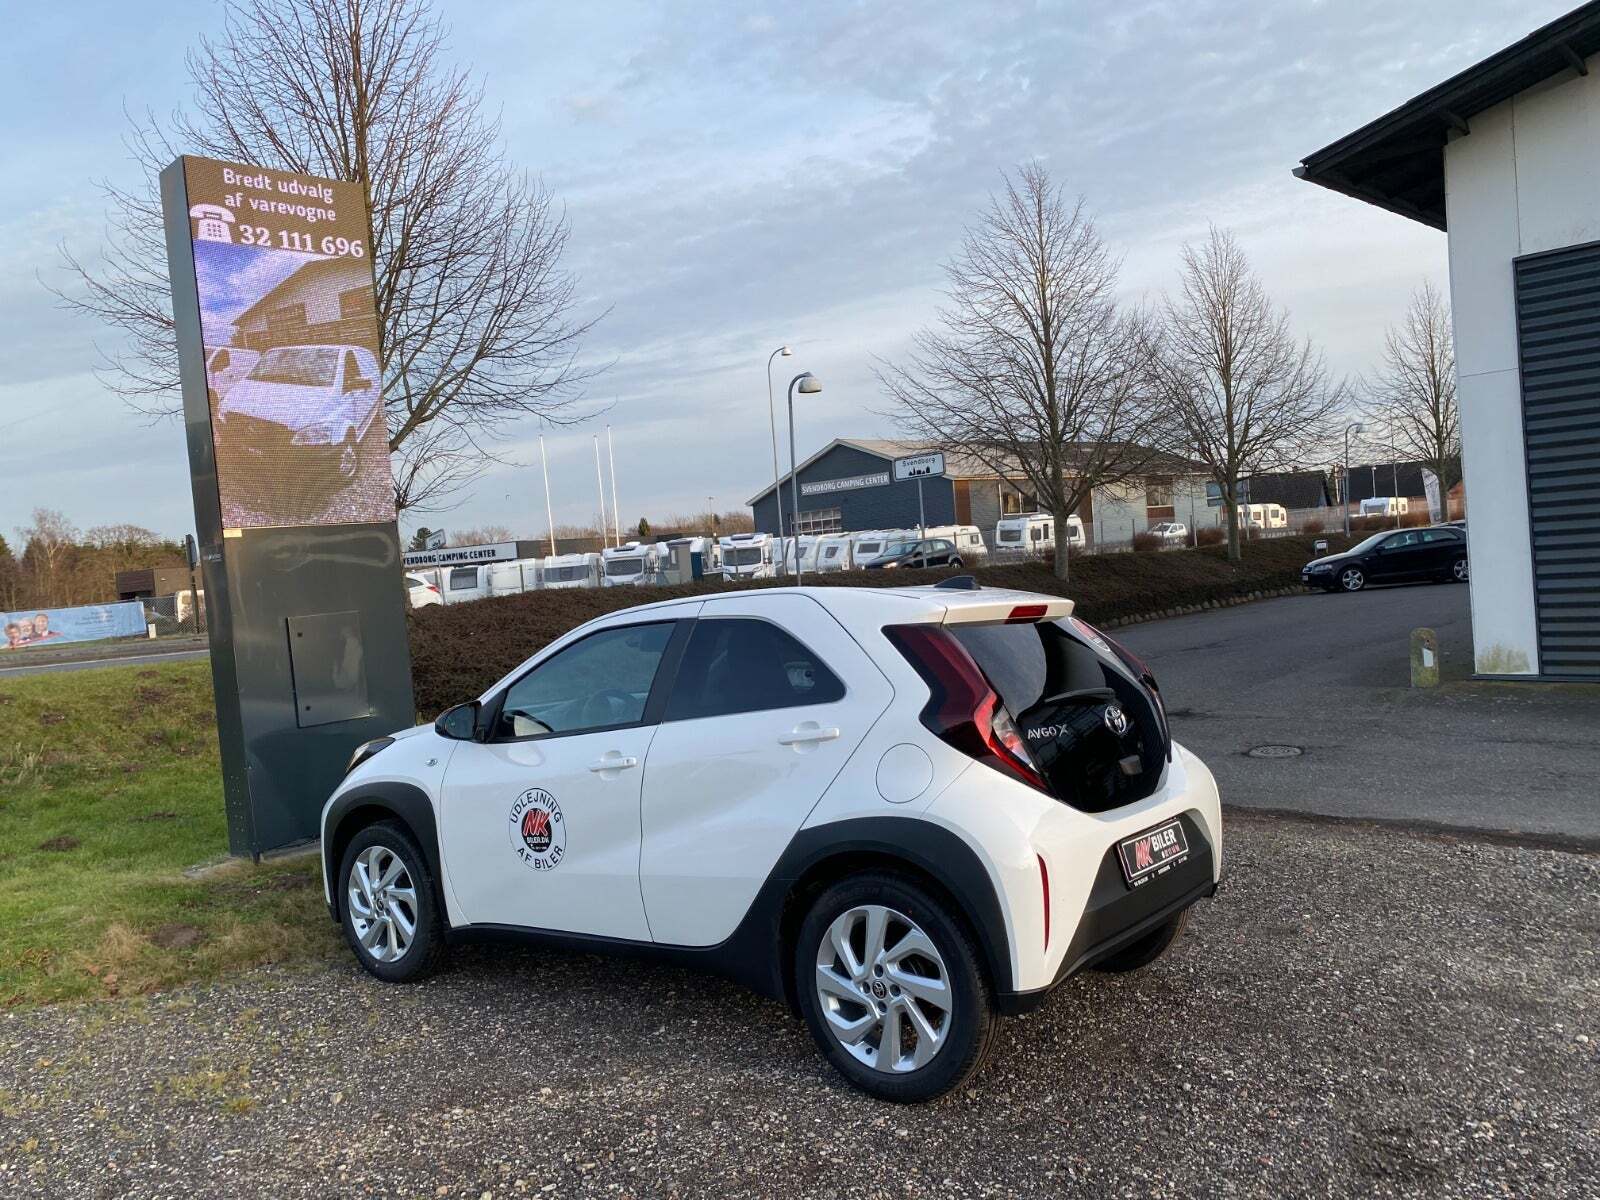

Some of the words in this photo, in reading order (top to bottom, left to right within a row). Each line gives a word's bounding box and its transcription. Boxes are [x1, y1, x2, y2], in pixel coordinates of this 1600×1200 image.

[223, 168, 272, 190] Bredt
[278, 179, 333, 204] udvalg
[224, 192, 244, 208] af
[249, 198, 337, 223] varevogne
[239, 224, 272, 247] 32
[279, 230, 314, 252] 111
[321, 236, 364, 258] 696
[902, 457, 936, 467] Svendborg
[802, 482, 836, 495] SVENDBORG
[837, 478, 864, 489] CAMPING
[865, 474, 889, 485] CENTER
[439, 551, 468, 561] CAMPING
[469, 549, 496, 559] CENTER
[510, 791, 562, 824] UDLEJNING
[523, 809, 550, 837] NK
[1151, 828, 1177, 852] BILER
[517, 847, 532, 862] AF
[534, 845, 563, 869] BILER
